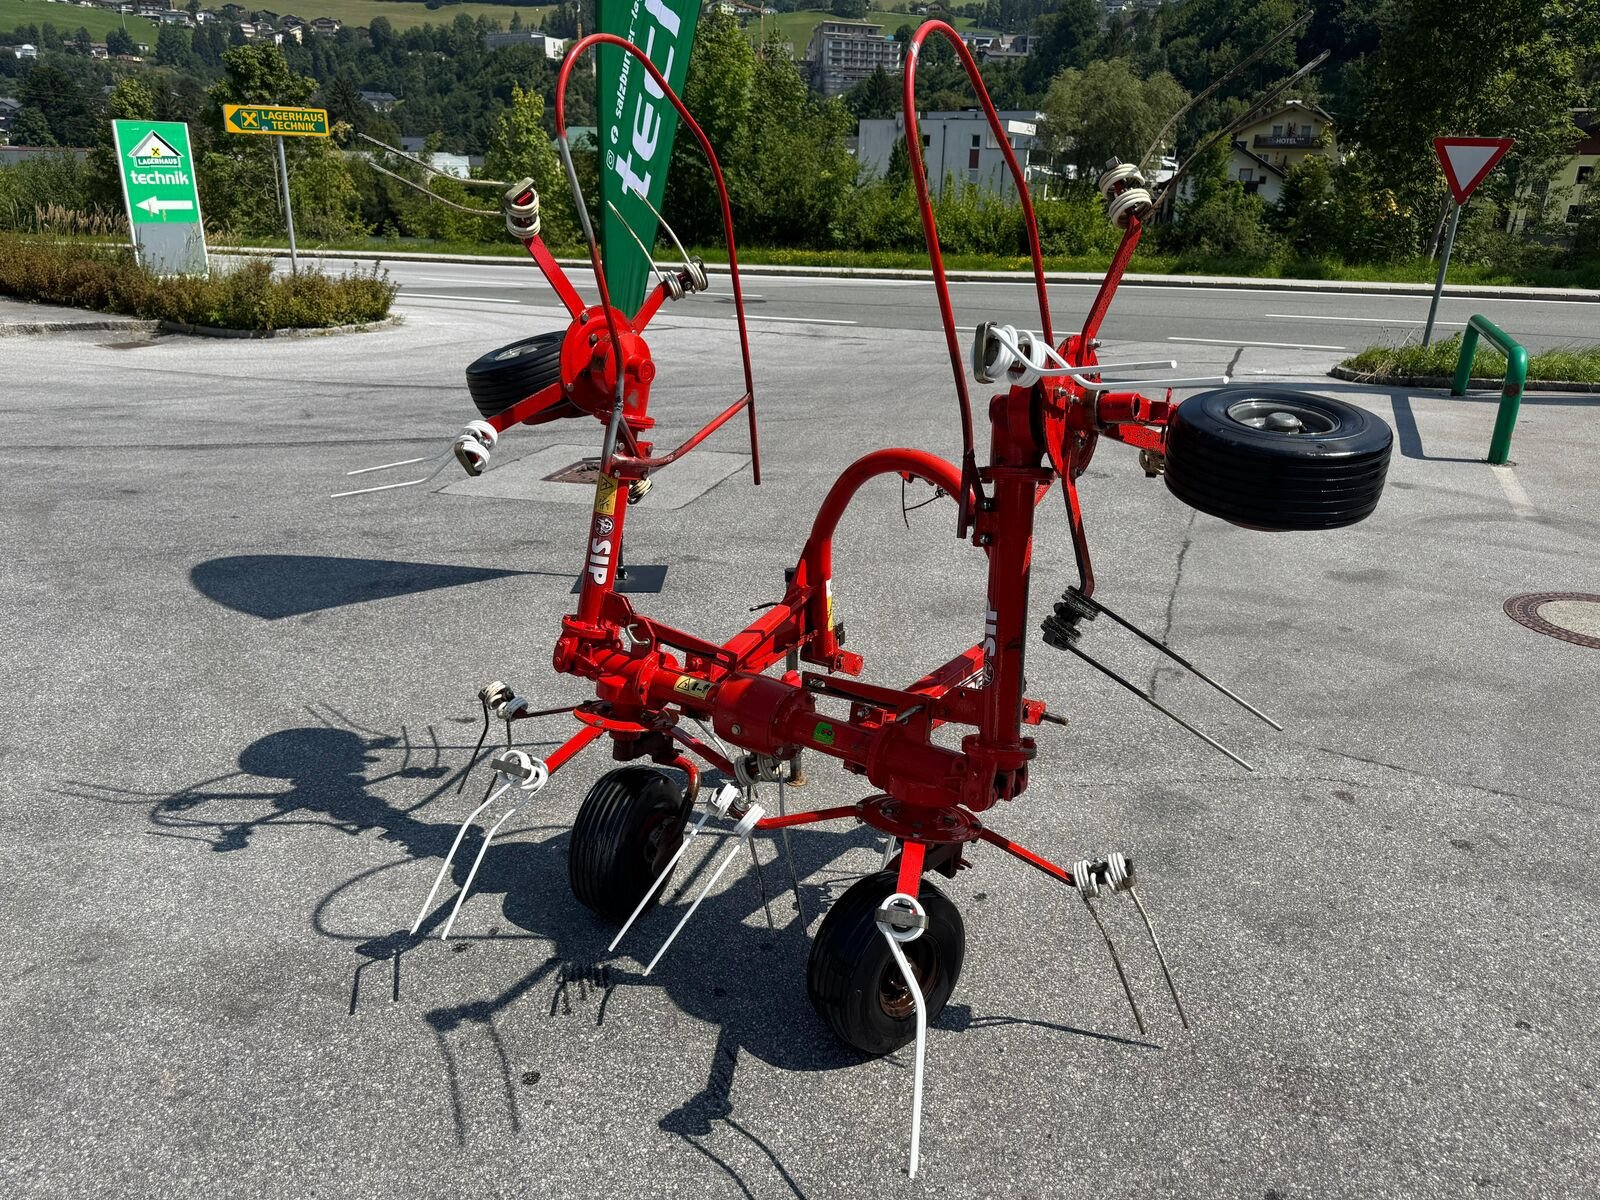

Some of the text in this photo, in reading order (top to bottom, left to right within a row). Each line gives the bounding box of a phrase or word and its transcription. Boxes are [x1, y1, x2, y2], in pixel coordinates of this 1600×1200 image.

[615, 0, 641, 119] salzburer-la
[261, 111, 323, 122] LAGERHAUS
[271, 121, 316, 131] TECHNIK
[130, 170, 189, 185] technik
[588, 537, 612, 585] SIP
